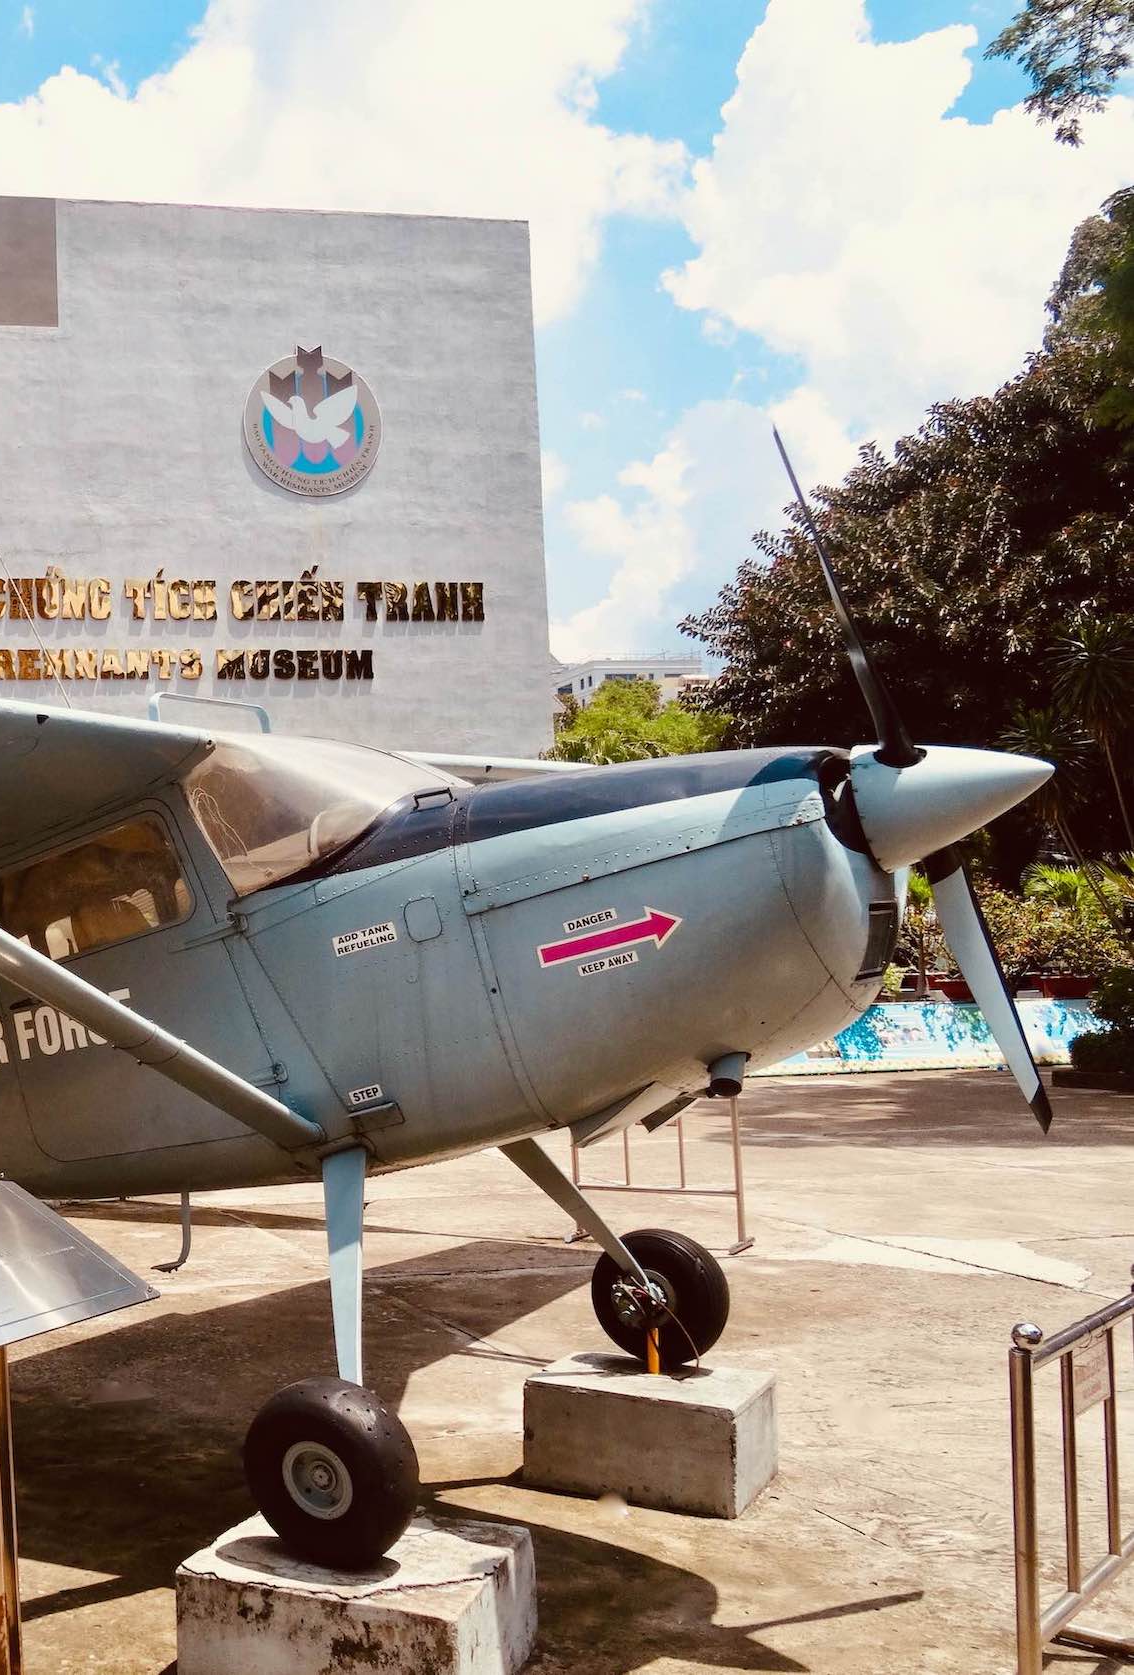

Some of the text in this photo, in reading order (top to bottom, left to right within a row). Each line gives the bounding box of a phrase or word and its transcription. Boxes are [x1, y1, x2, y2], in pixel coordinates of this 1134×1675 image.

[124, 568, 217, 621] TÍCH
[230, 565, 344, 621] CHIẾN
[357, 581, 484, 621] TRANH
[217, 649, 374, 680] MUSEUM
[567, 911, 613, 931] DANGER
[337, 933, 395, 955] REFUELING
[338, 924, 390, 945] ADD TANK
[581, 953, 634, 974] KEEP AWAY
[13, 988, 130, 1060] FOR
[353, 1087, 378, 1101] STEP
